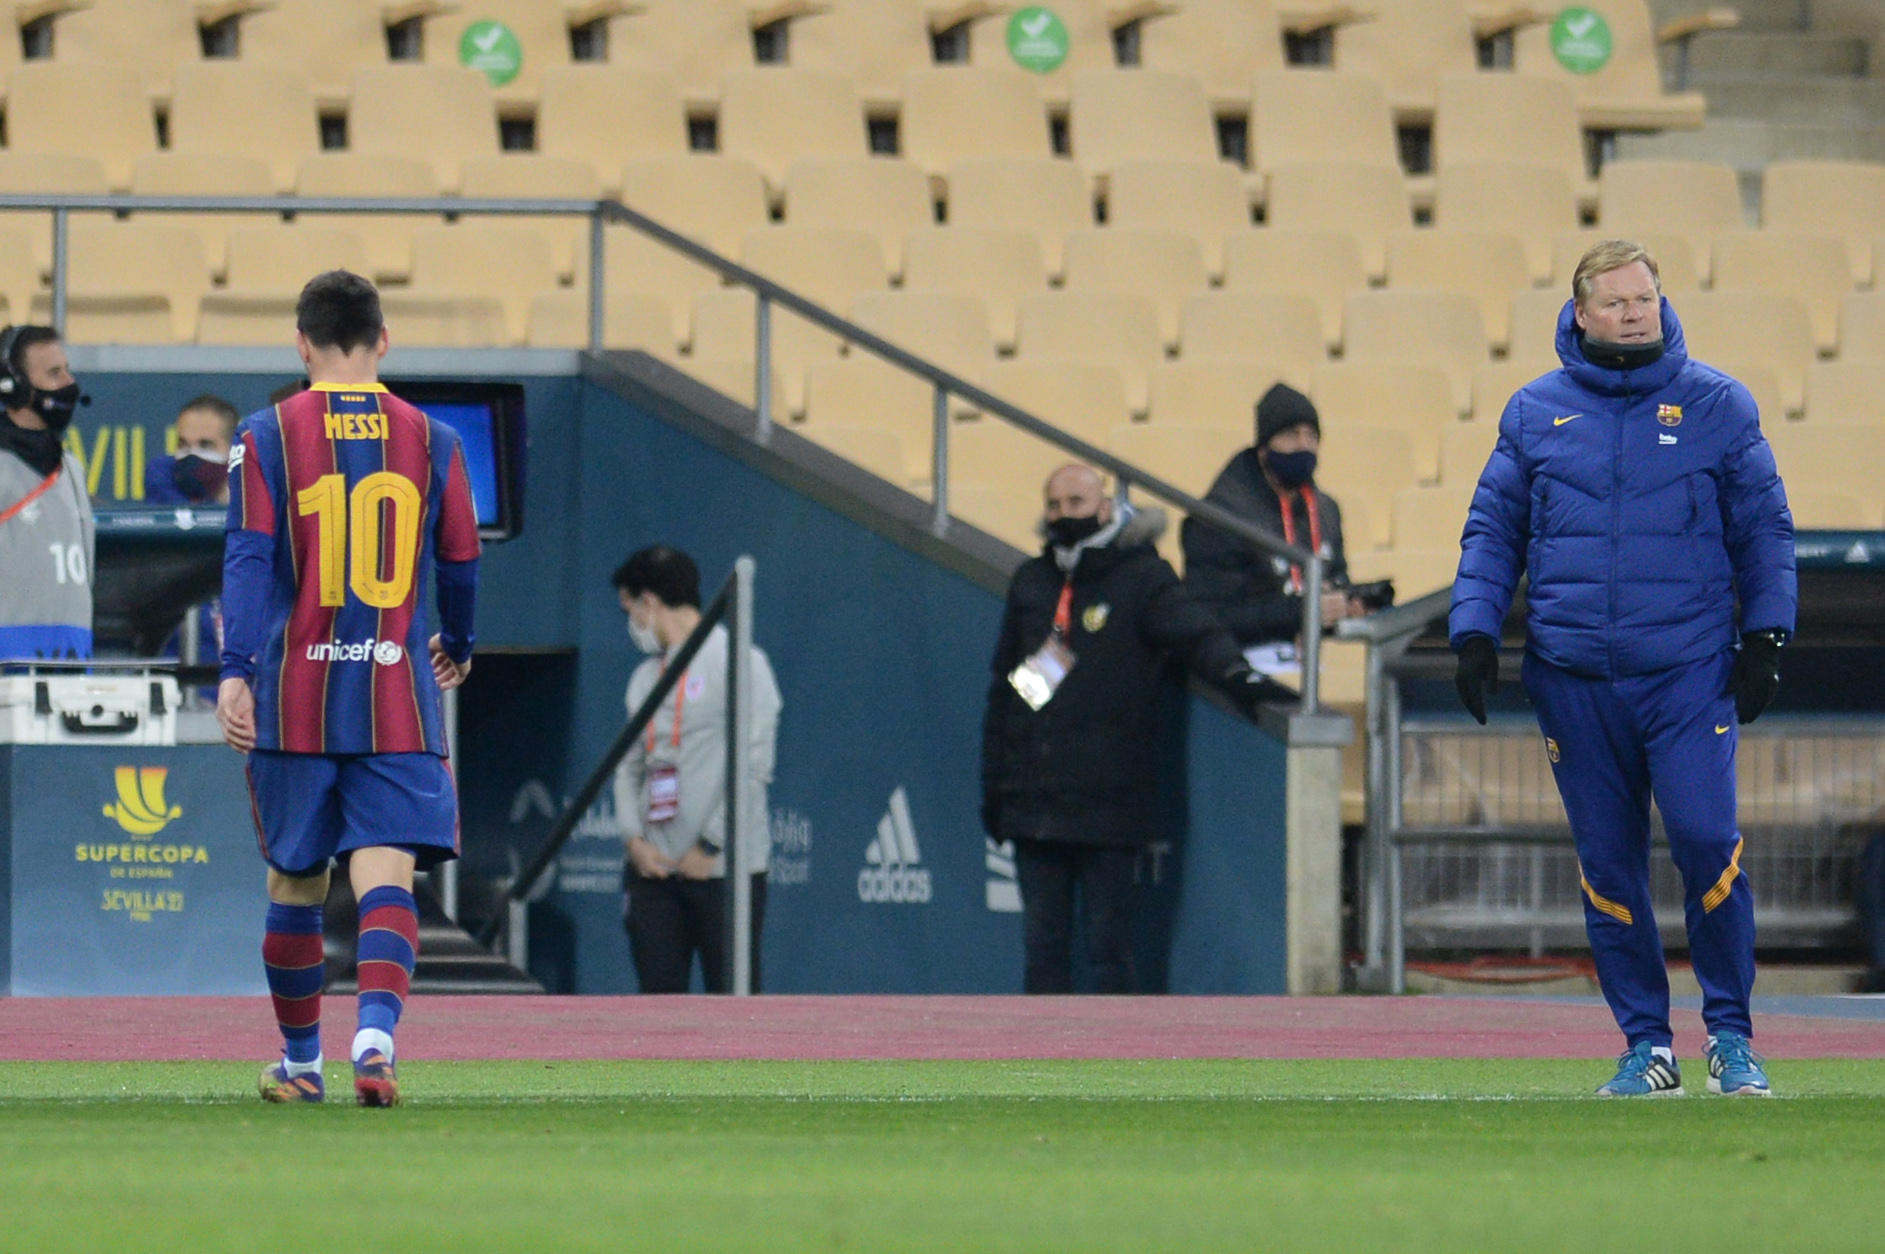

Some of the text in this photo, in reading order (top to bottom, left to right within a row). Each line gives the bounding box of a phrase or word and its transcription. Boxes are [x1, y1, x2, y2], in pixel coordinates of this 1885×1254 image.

[323, 413, 389, 440] MESSI
[297, 471, 422, 609] 10
[49, 543, 88, 585] 10
[306, 638, 375, 662] unicef
[75, 844, 209, 864] SUPERCOPA
[858, 862, 933, 904] adidas
